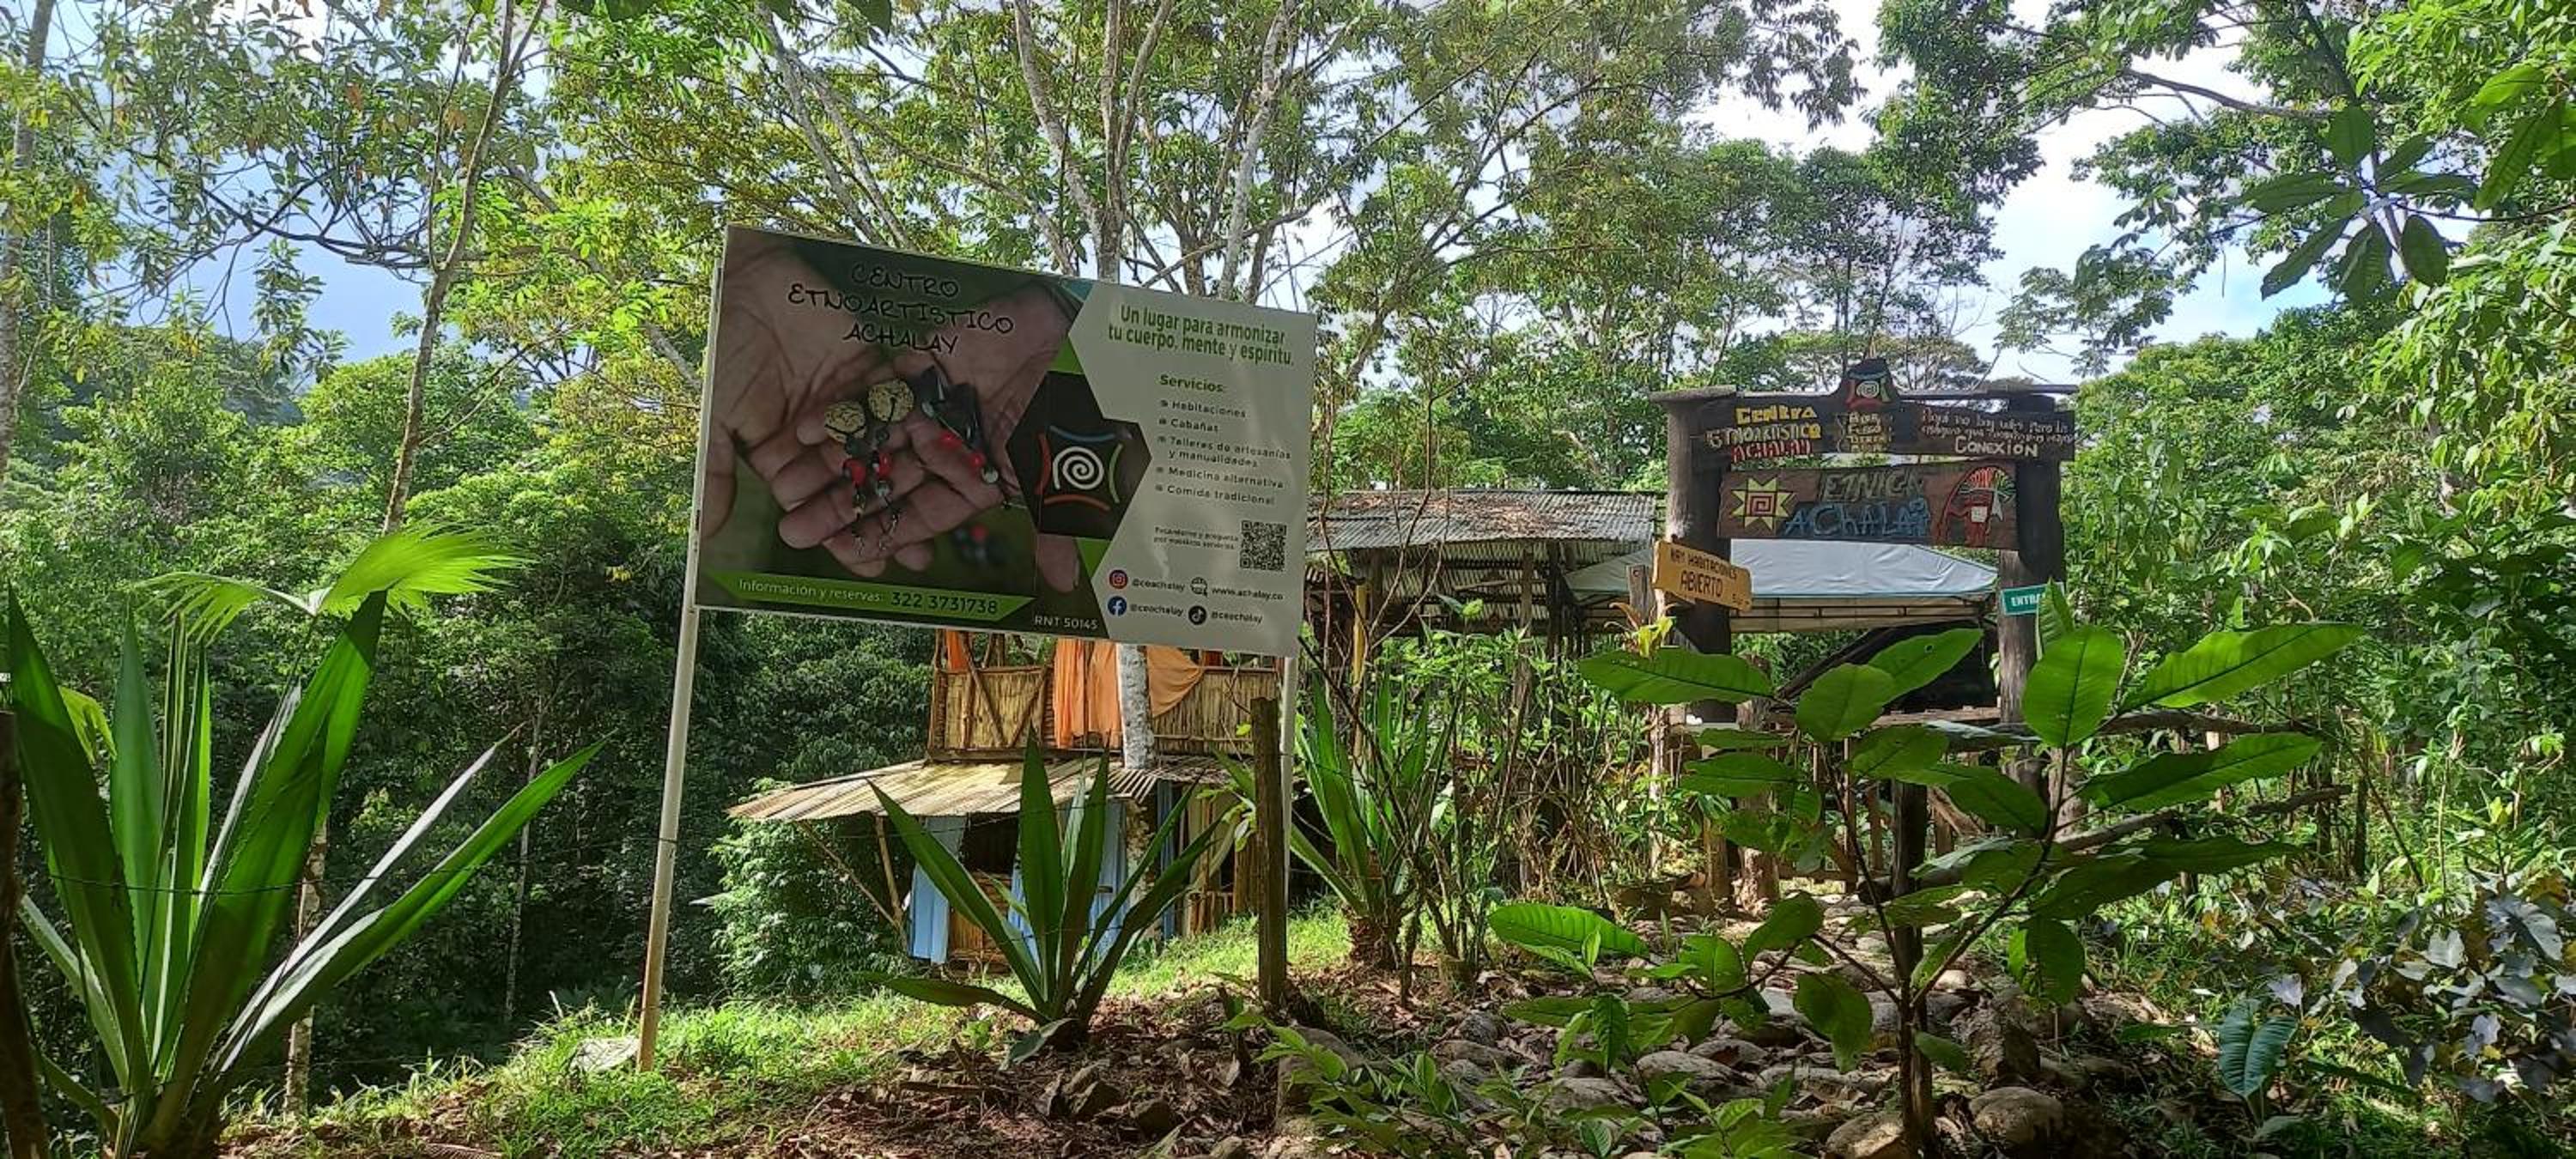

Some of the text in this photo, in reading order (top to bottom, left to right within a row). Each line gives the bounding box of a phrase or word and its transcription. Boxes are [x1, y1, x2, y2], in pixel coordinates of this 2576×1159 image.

[851, 261, 958, 298] CENTRO
[1121, 305, 1285, 344] Un lugar para armonizar
[842, 323, 958, 355] ACHALAY
[1109, 324, 1121, 340] tu
[1127, 327, 1179, 352] cuerpo,
[1182, 334, 1225, 355] mente
[1226, 344, 1237, 360] y
[1172, 401, 1246, 418] Habitaciones
[1170, 418, 1218, 433] Cabañas
[1169, 450, 1258, 468] y manualidades
[1170, 436, 1291, 460] Talleres de artesanías
[1168, 466, 1284, 488] Medicina alternativa
[1821, 470, 1923, 502] ETNICA
[1167, 485, 1275, 506] Comida tradicional
[1680, 569, 1723, 598] ABIERTO
[739, 579, 816, 597] Información
[819, 589, 826, 599] y
[891, 592, 922, 609] 322
[928, 595, 997, 615] 3731738
[1035, 614, 1098, 630] RNT 50145
